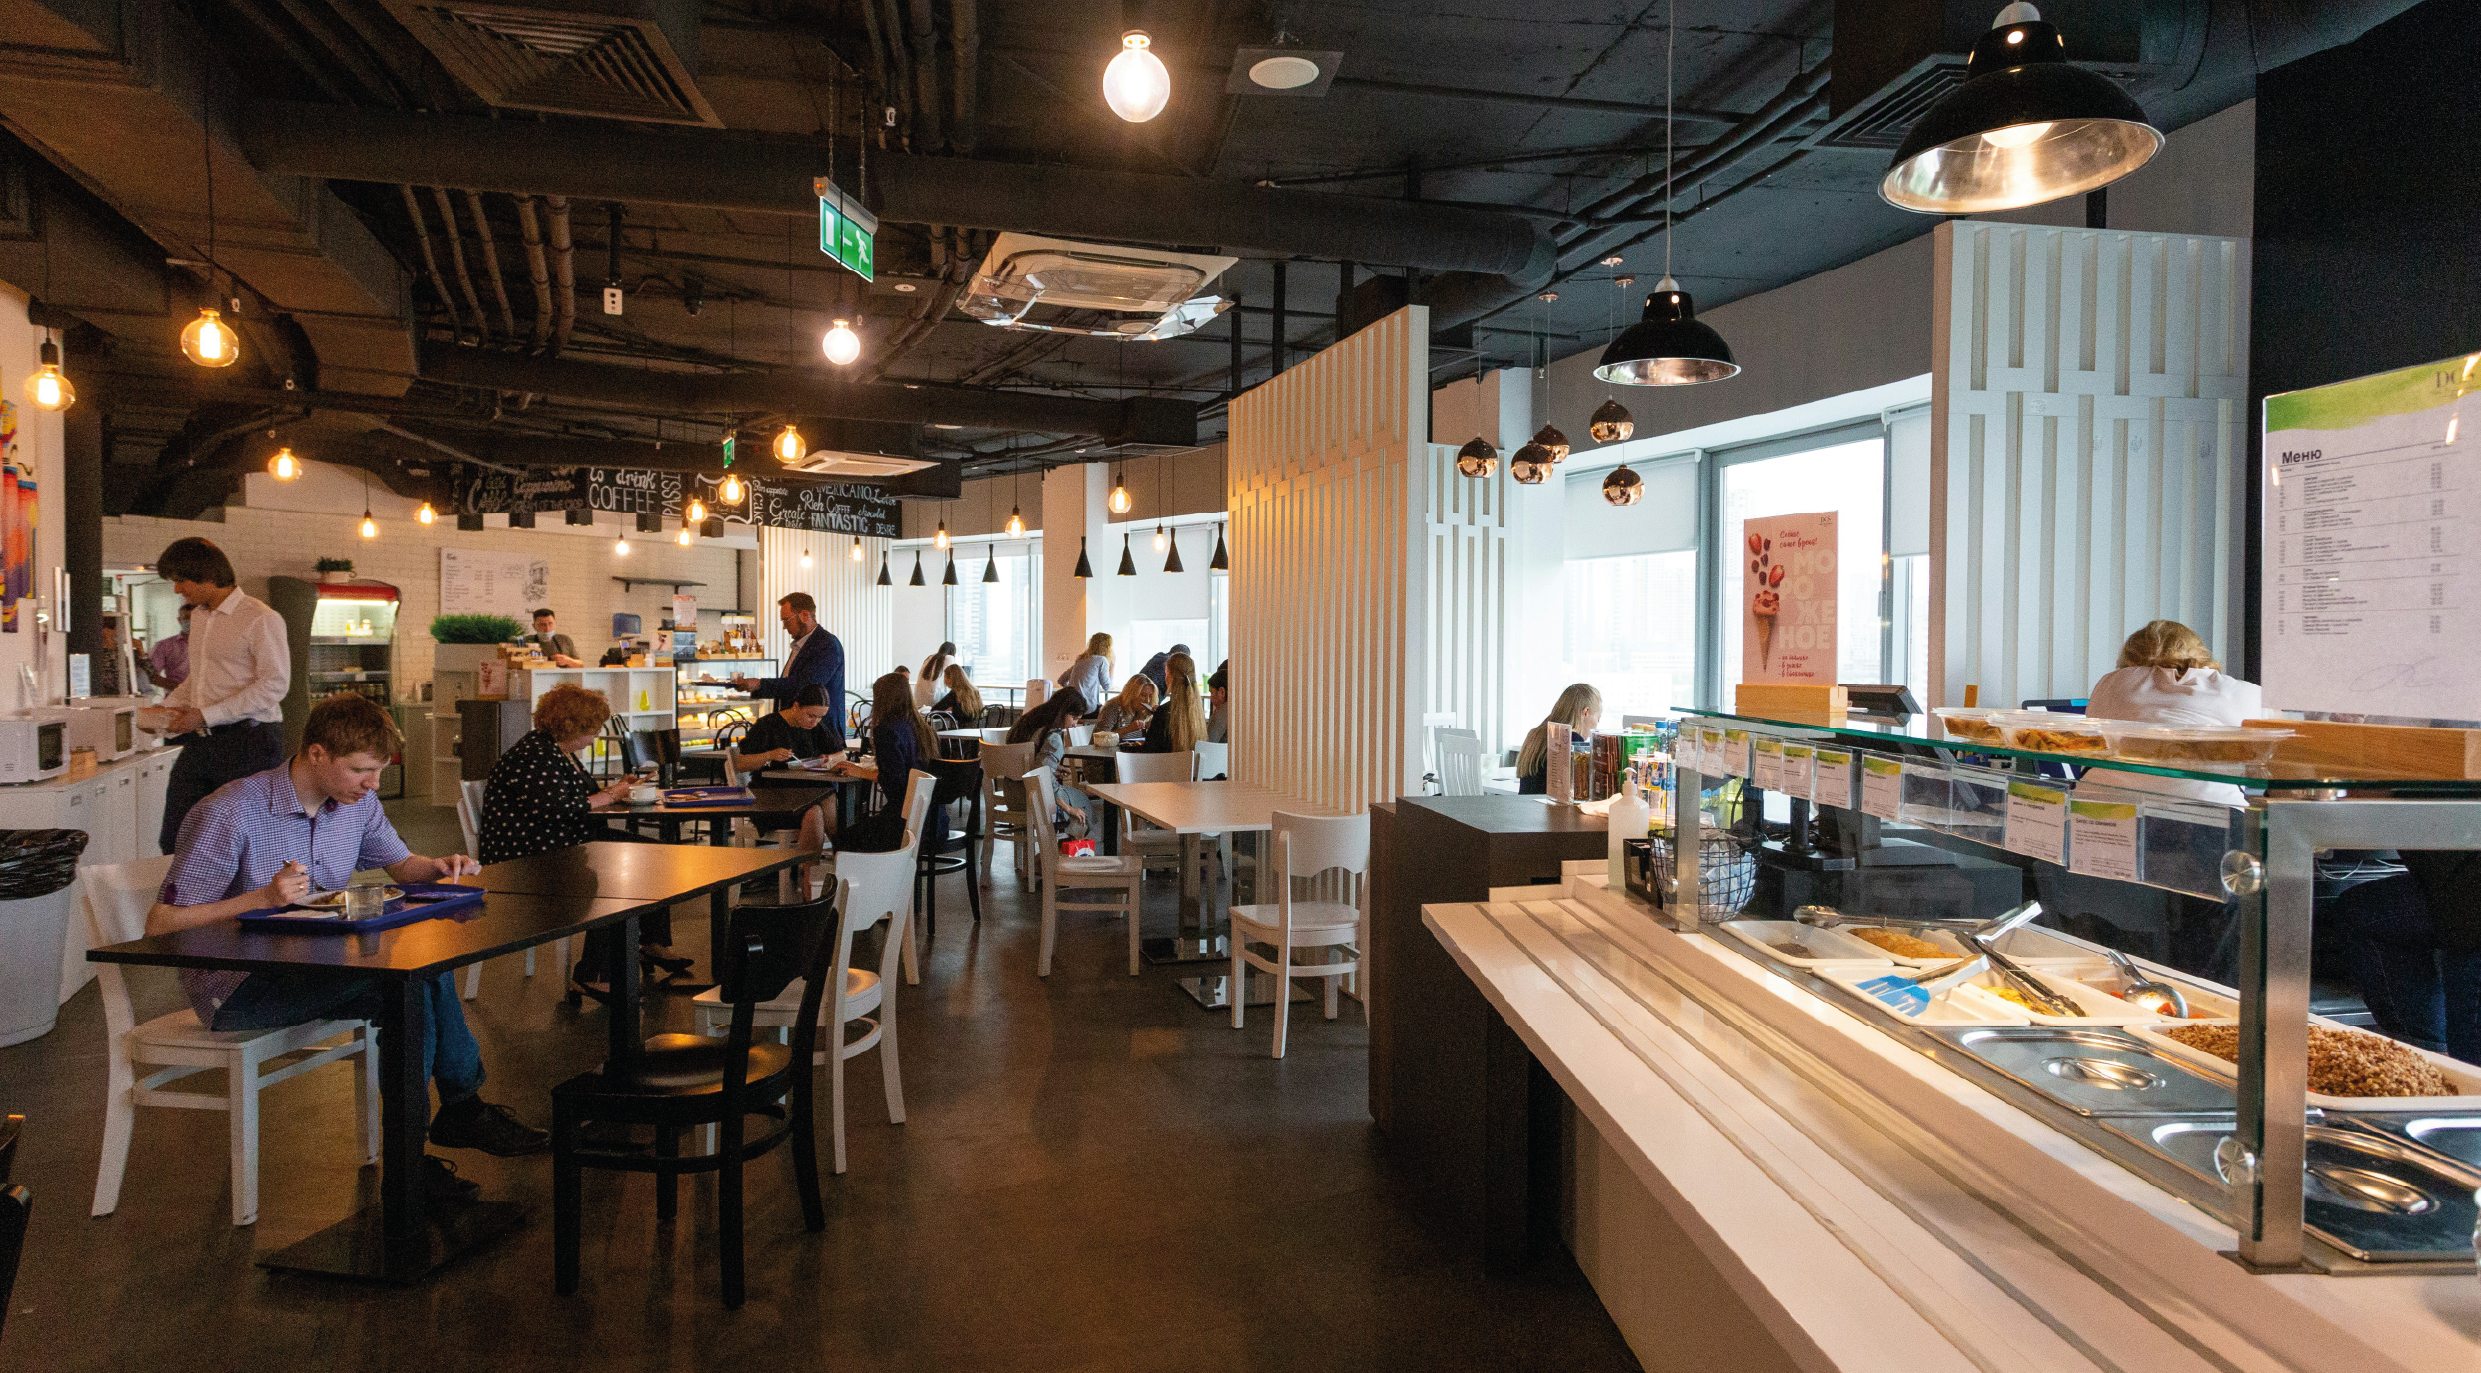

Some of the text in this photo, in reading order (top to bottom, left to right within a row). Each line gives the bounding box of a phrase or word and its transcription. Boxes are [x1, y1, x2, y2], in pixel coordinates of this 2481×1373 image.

[2281, 448, 2323, 465] Меню
[615, 468, 657, 490] drink
[588, 483, 658, 514] COFFEE
[811, 512, 869, 534] FANTASTIC
